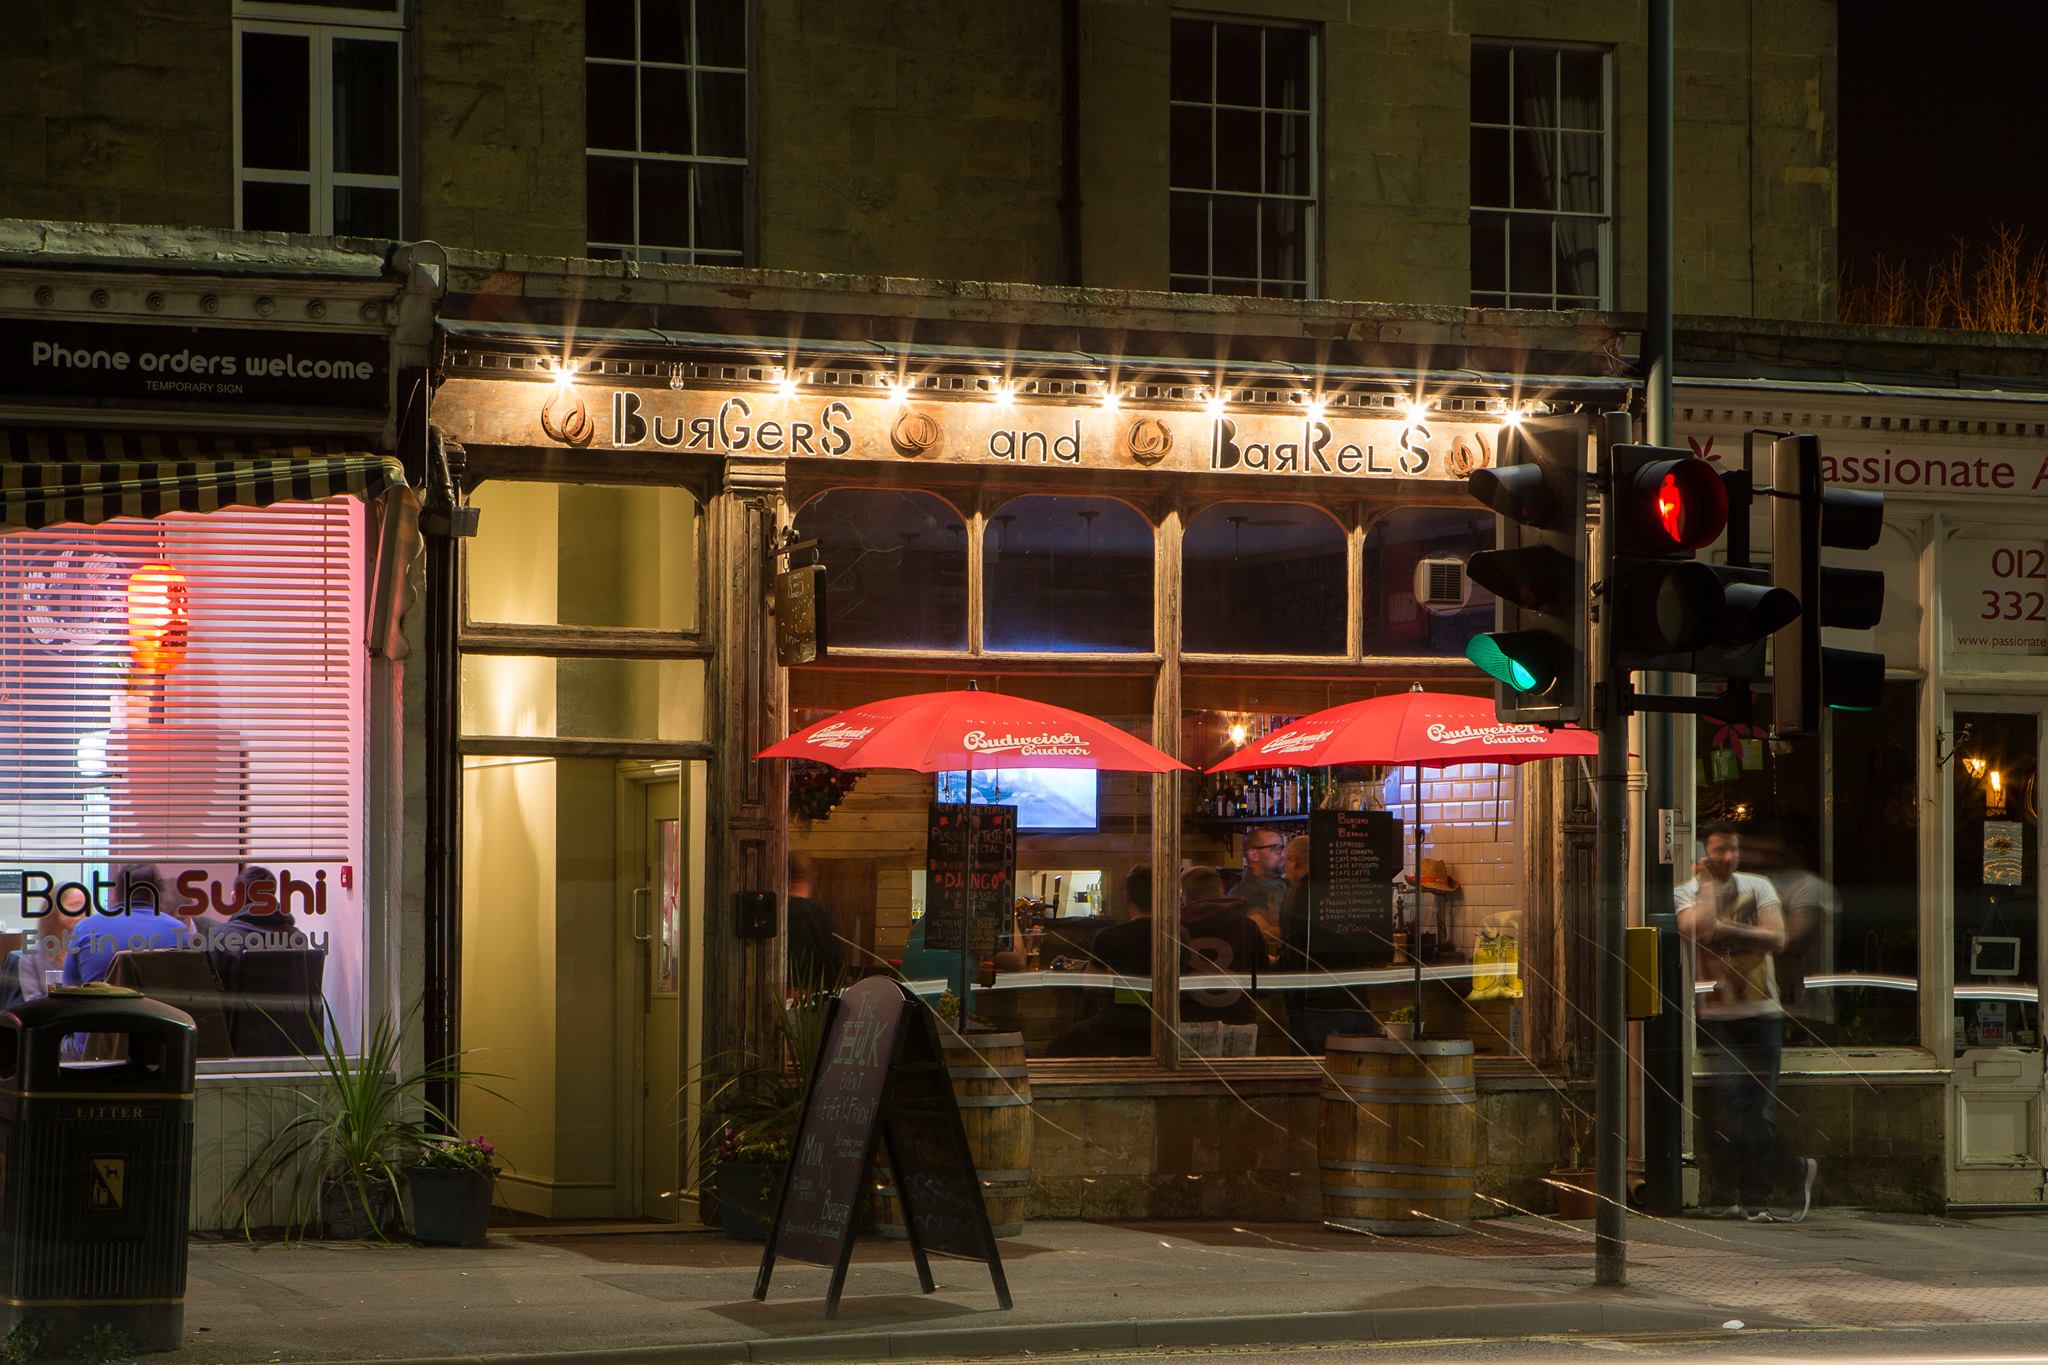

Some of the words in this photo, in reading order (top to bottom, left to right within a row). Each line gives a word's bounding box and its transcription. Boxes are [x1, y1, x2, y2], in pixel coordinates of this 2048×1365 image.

[33, 341, 131, 370] Phone
[139, 349, 237, 376] orders
[245, 353, 373, 380] welcome
[146, 380, 214, 393] TEMPORARY
[216, 383, 243, 394] SIGN
[989, 418, 1083, 465] and
[1821, 449, 2016, 489] assionate
[1991, 548, 2047, 579] 012
[1981, 590, 2047, 622] 332
[963, 730, 1090, 754] Budweiser
[1427, 723, 1545, 745] Budweiser
[1482, 734, 1547, 745] Budvar
[1021, 743, 1092, 756] Budvar
[20, 870, 161, 918] Bath
[176, 868, 328, 917] Sushi
[21, 929, 81, 955] Eat
[89, 929, 119, 954] in
[127, 932, 161, 953] or
[171, 927, 329, 955] Takeaway
[75, 1106, 144, 1119] LITTER
